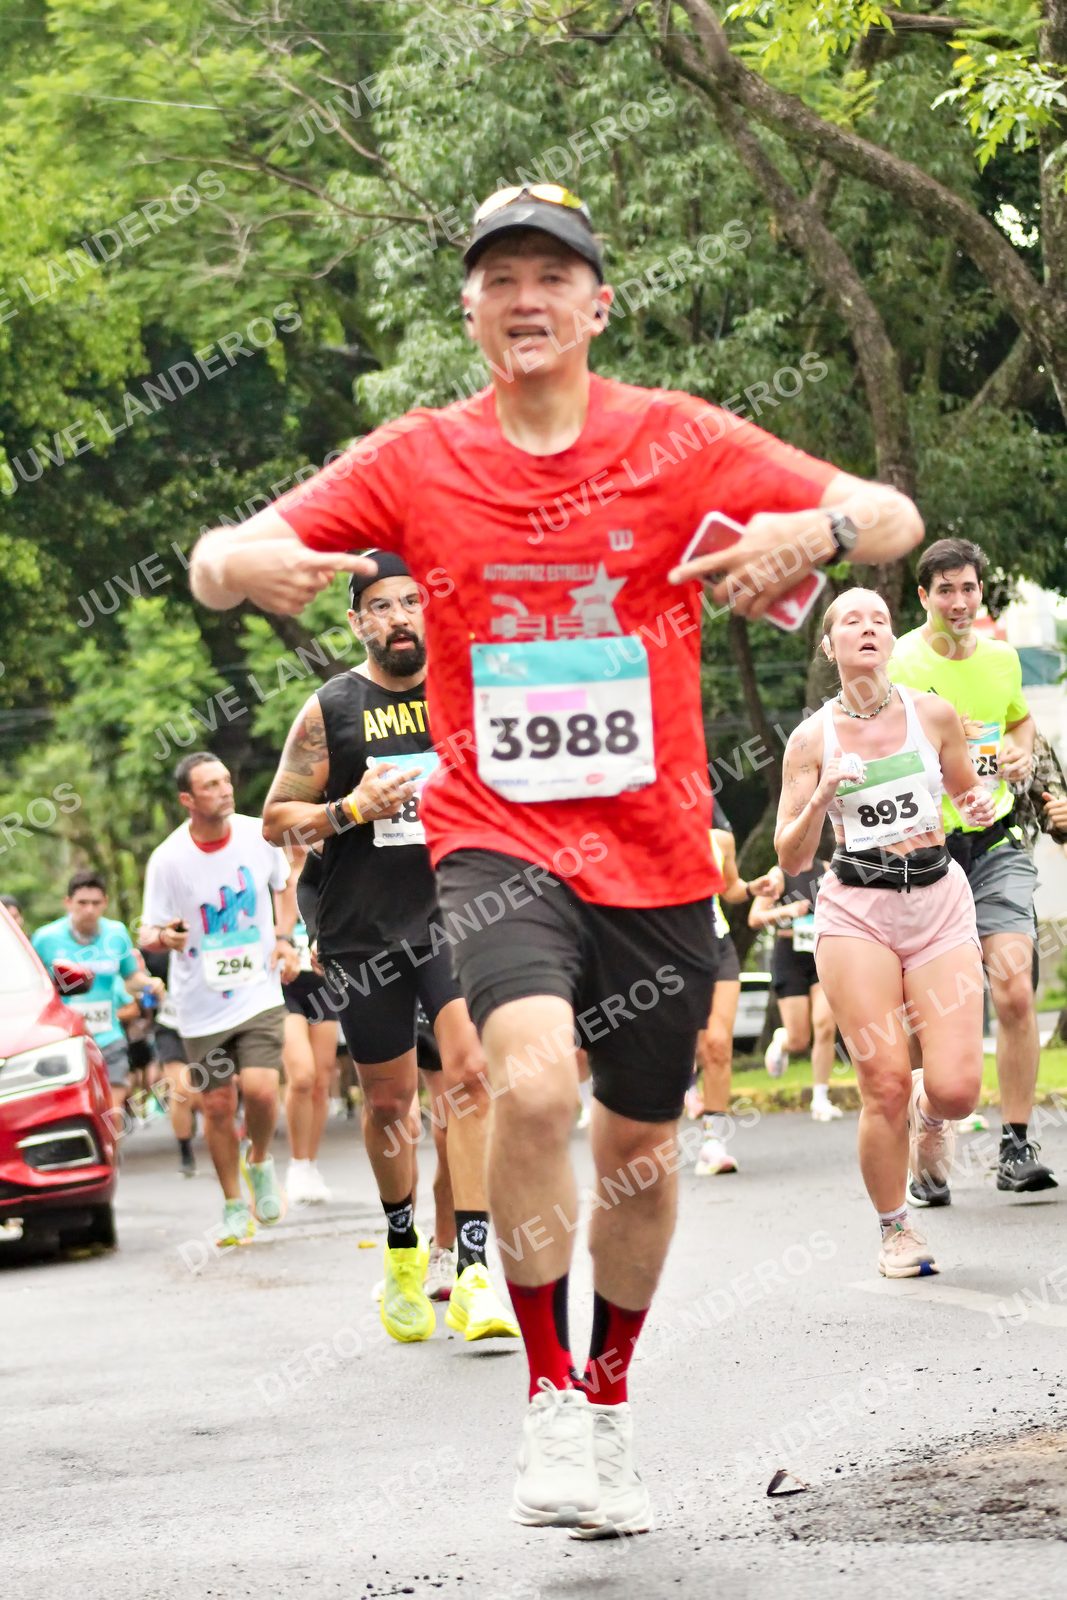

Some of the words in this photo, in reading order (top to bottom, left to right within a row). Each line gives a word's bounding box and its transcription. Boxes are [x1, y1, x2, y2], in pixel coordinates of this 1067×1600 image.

[363, 700, 431, 742] AMAT
[490, 709, 639, 761] 3988
[972, 754, 998, 777] 25
[857, 791, 919, 828] 893
[216, 956, 253, 976] 294
